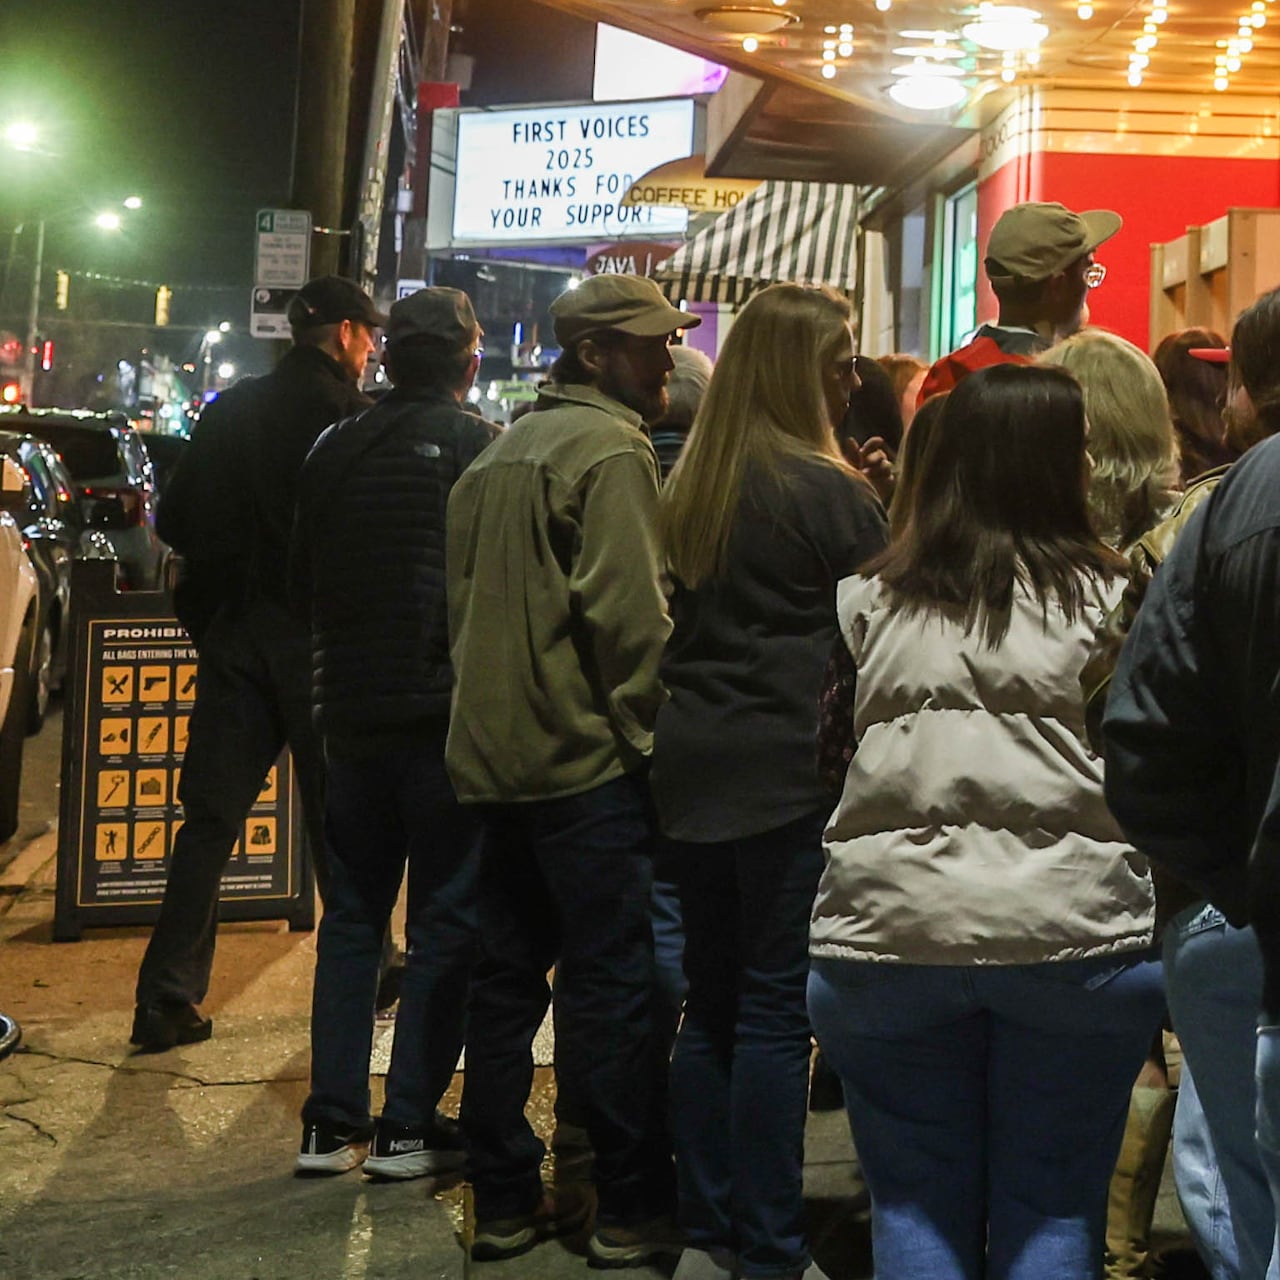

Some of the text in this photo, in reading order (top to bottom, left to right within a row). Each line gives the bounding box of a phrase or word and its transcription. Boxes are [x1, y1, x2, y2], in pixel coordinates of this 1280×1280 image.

[513, 115, 650, 144] FIRST VOICES
[546, 147, 594, 170] 2025
[503, 176, 576, 200] THANKS
[629, 185, 707, 206] COFFEE
[491, 204, 654, 229] YOUR SUPPORT
[595, 255, 637, 276] JAVA
[102, 650, 116, 661] ALL
[137, 649, 173, 659] ENTERING
[174, 648, 187, 658] THE
